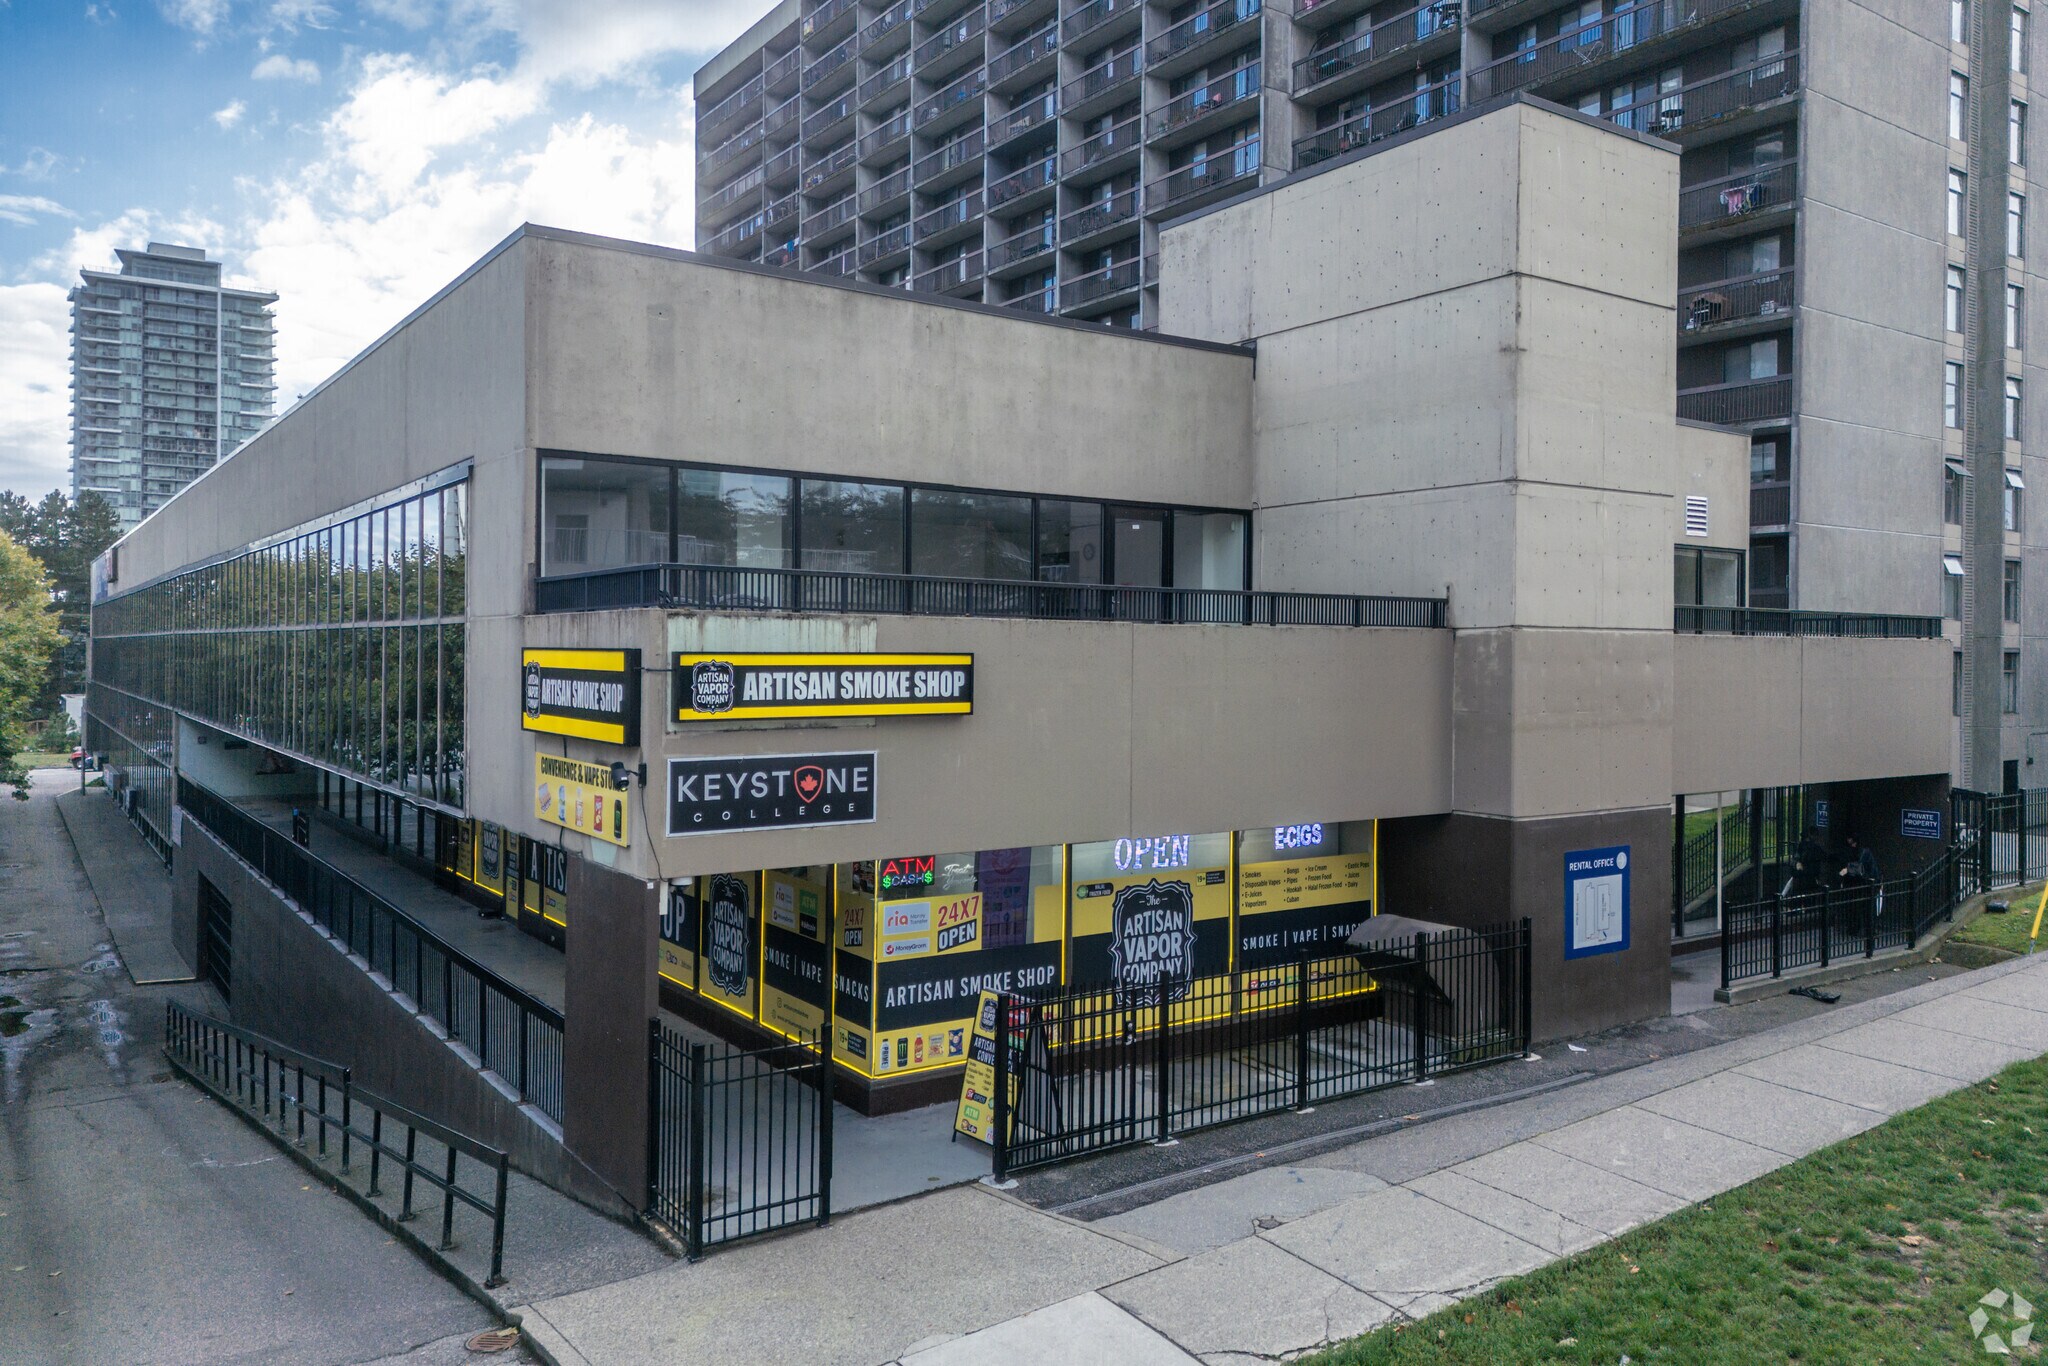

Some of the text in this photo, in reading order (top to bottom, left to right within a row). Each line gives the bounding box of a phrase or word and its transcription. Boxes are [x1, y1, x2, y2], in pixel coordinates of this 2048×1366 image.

[697, 672, 729, 683] ARTISAN
[697, 683, 729, 694] VAPOR
[742, 670, 965, 701] ARTISAN SMOKE SHOP
[541, 678, 623, 713] ARTISAN SMOKE SHOP
[696, 694, 729, 705] COMPANY
[540, 757, 577, 782] CONVENIENCE
[577, 764, 583, 783] &
[584, 766, 600, 787] VAPE
[693, 803, 855, 823] COLLEGE
[1904, 818, 1938, 828] PROPERTY
[1907, 812, 1934, 821] PRIVATE
[1274, 823, 1323, 850] E-CIGS
[1114, 835, 1190, 870] OPEN
[1569, 857, 1615, 872] RENTAL OFFICE
[882, 857, 935, 876] ATM
[938, 896, 980, 928] 24X7
[1145, 894, 1161, 907] The
[713, 900, 744, 929] ARTISAN
[844, 908, 865, 927] 24X7
[887, 911, 909, 928] ria
[1124, 909, 1183, 938] ARTISAN
[713, 920, 743, 955] VAPOR
[844, 929, 863, 946] OPEN
[895, 943, 927, 952] MoneyGram
[938, 922, 976, 950] OPEN
[1123, 931, 1183, 964] VAPOR
[1243, 933, 1278, 951] SMOKE
[1293, 928, 1318, 943] VAPE
[713, 945, 743, 973] COMPANY
[764, 945, 822, 984] SMOKE VAPE
[1122, 956, 1184, 985] COMPANY
[834, 973, 869, 1003] SNACKS
[885, 965, 1056, 1009] ARTISAN SMOKE SHOP
[881, 1046, 889, 1066] PRIME
[965, 1108, 980, 1119] ATM
